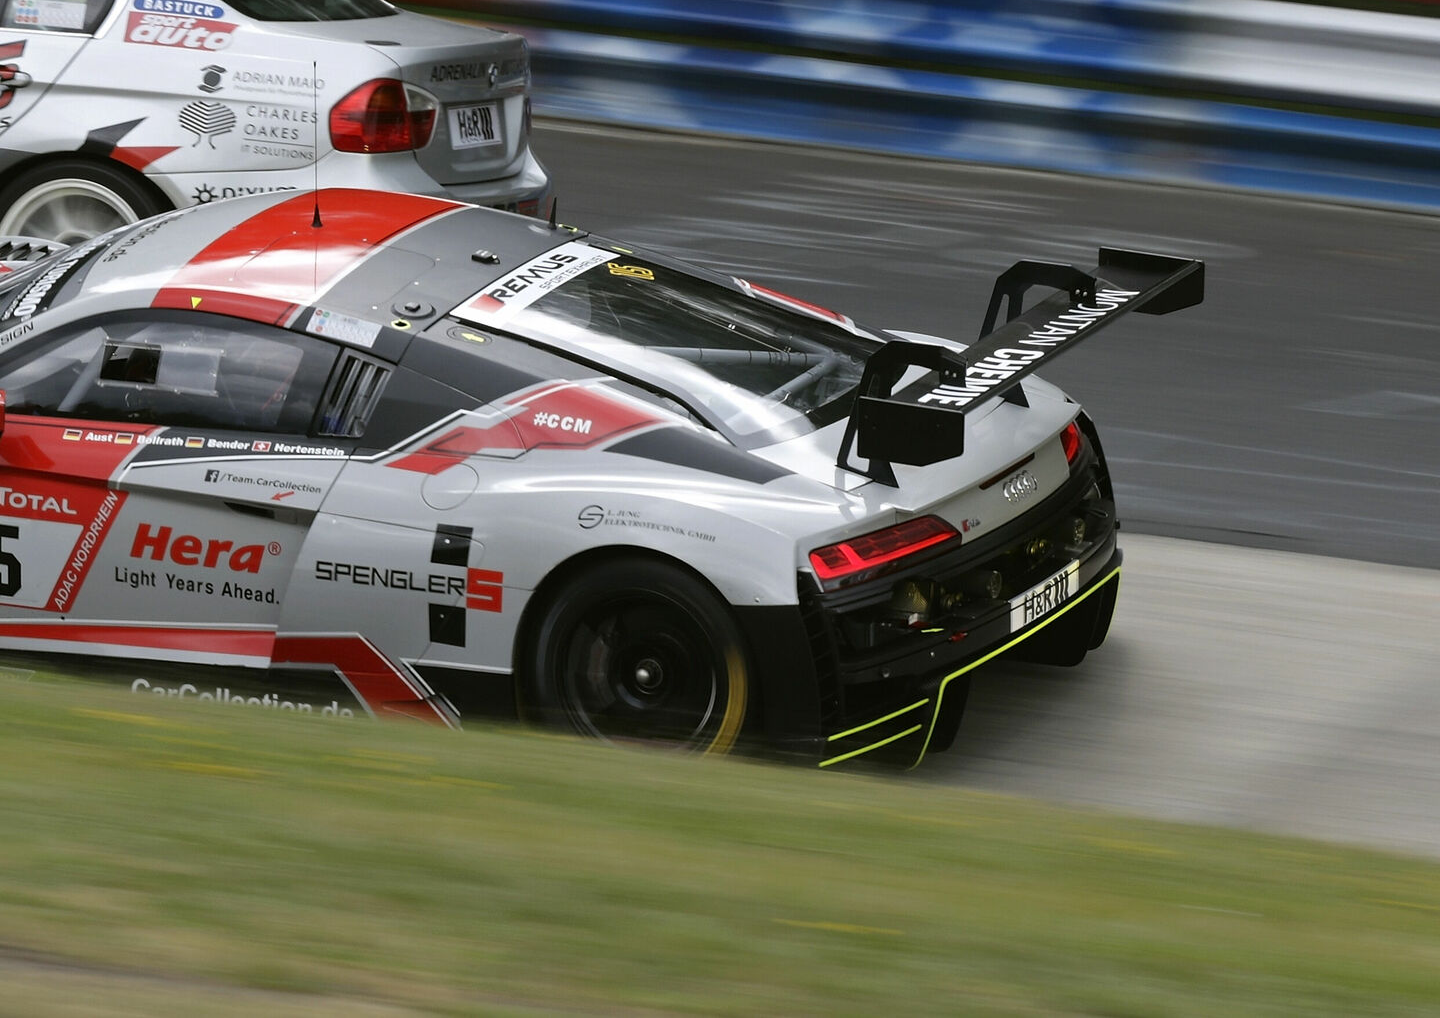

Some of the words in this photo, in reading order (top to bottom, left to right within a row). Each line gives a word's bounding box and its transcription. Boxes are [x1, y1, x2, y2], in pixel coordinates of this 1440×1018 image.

[139, 14, 197, 30] sport
[128, 24, 234, 52] auto
[232, 70, 284, 86] ADRIAN
[246, 104, 319, 124] CHARLES
[243, 122, 300, 140] OAKES
[253, 145, 315, 161] SOLUTIONS
[487, 252, 579, 305] REMUS
[1018, 288, 1141, 346] MONTAN
[916, 347, 1046, 407] CHEMIE
[533, 411, 592, 434] #CCM
[85, 432, 113, 443] Aust
[136, 434, 184, 448] Bollrath
[206, 438, 250, 451] Bender
[273, 443, 345, 457] Hertenstein
[604, 519, 686, 537] ELEKTROTECHNIK
[53, 570, 78, 611] ADAC
[71, 490, 119, 572] NORDRHEIN
[114, 566, 157, 589] Light
[166, 573, 214, 595] Years
[221, 582, 280, 605] Ahead.
